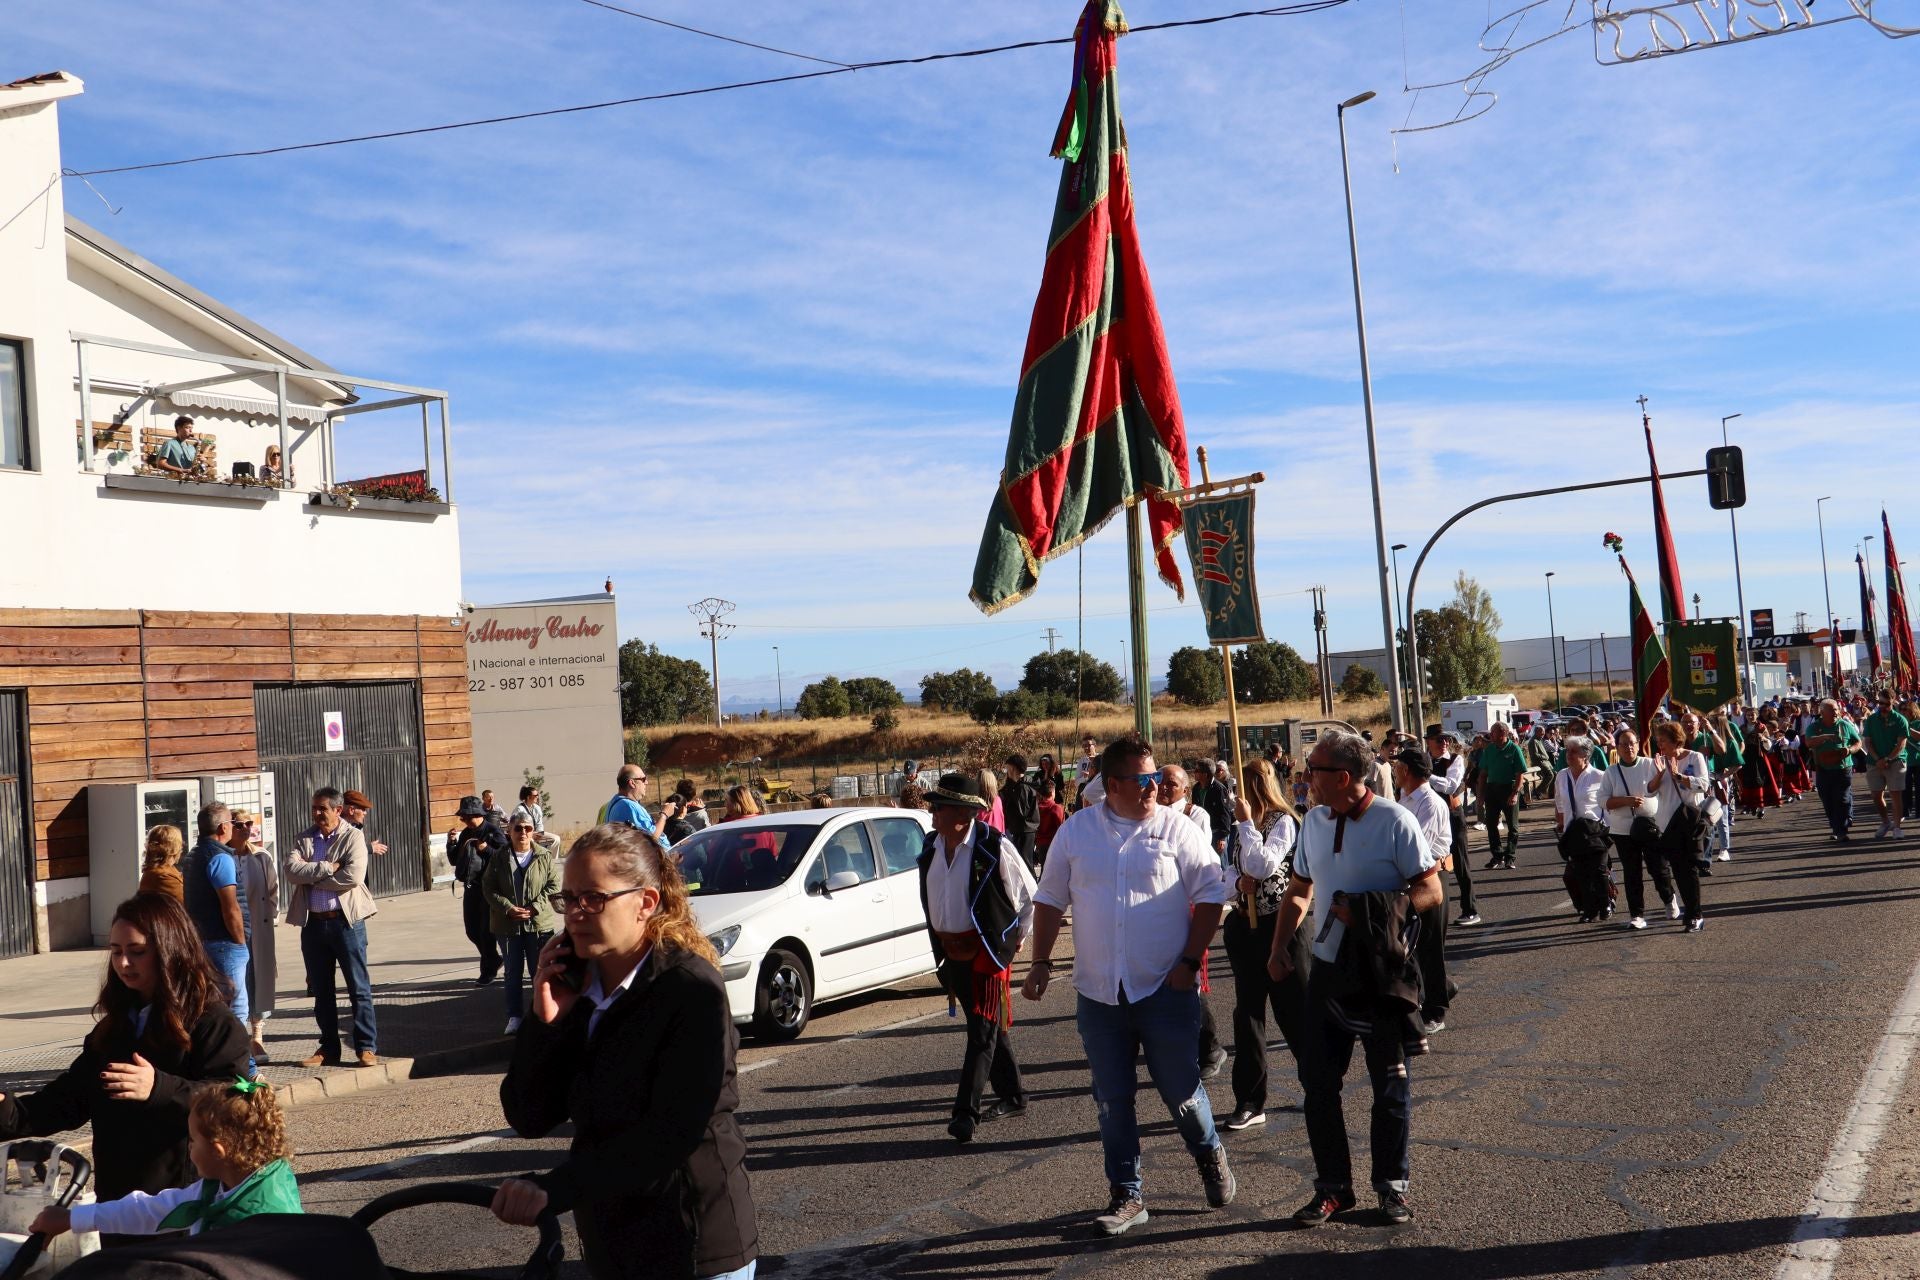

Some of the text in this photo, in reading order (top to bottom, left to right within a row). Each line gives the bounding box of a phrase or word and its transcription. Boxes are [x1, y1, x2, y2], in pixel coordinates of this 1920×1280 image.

[470, 618, 544, 650] Alvarez
[546, 615, 605, 640] Castro
[479, 657, 526, 669] Nacional
[529, 658, 536, 667] e
[538, 653, 605, 667] internacional
[500, 677, 525, 691] 987
[531, 676, 554, 689] 301
[560, 674, 586, 687] 085
